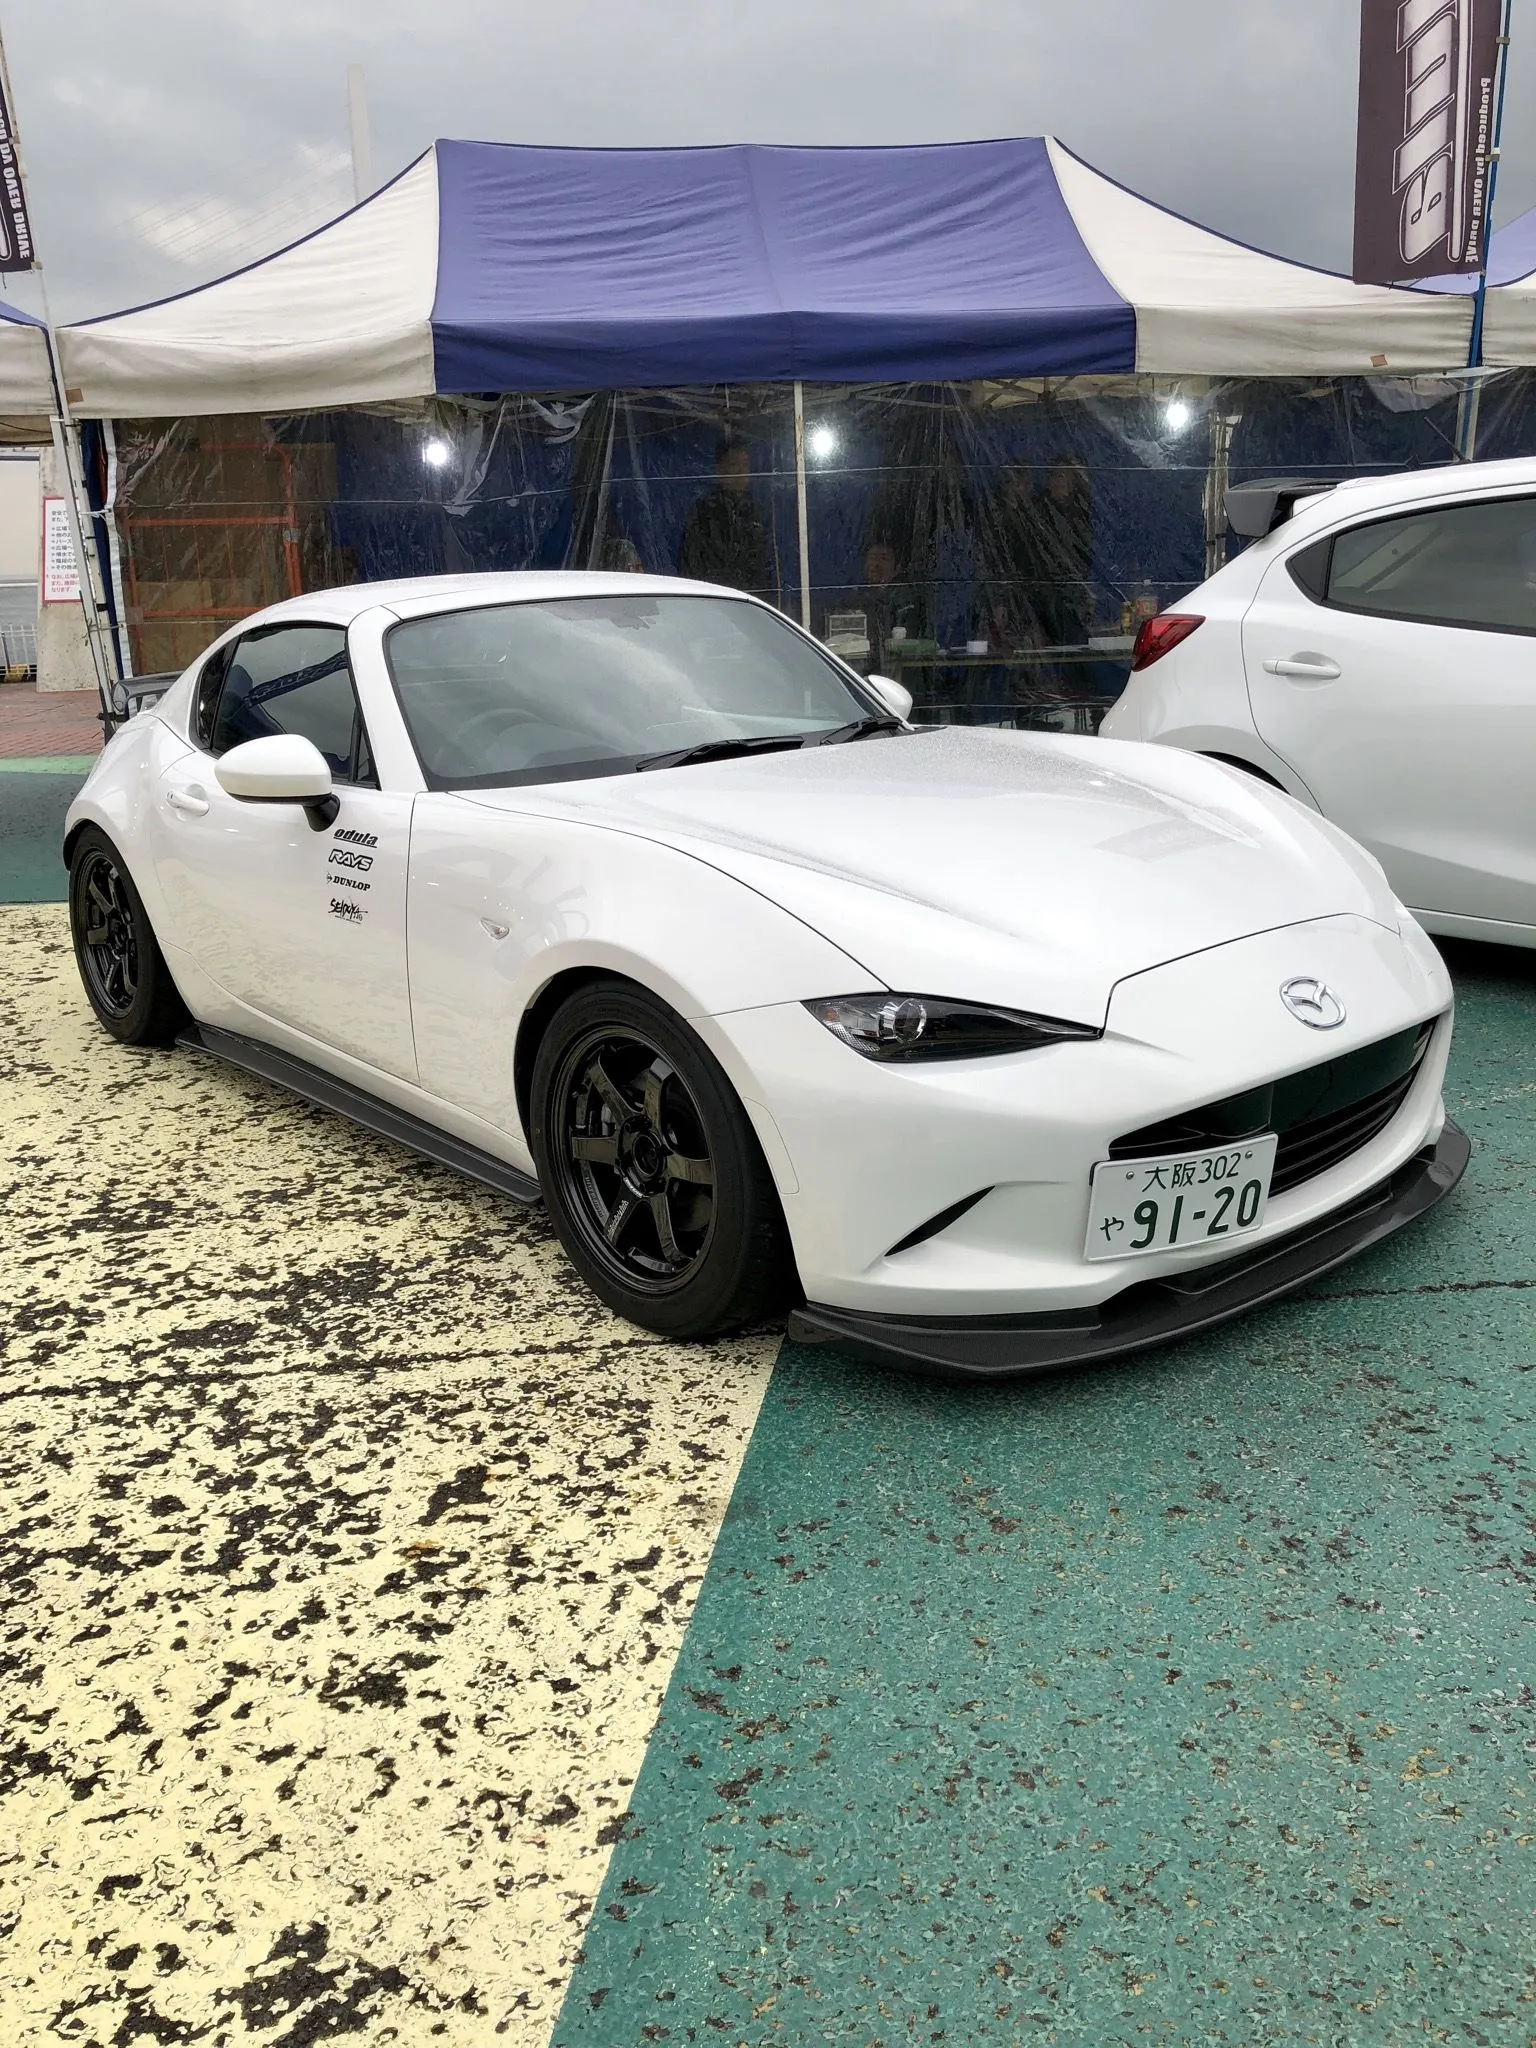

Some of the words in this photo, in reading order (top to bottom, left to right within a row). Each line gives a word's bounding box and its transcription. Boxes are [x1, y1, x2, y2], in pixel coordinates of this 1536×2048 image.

[333, 828, 378, 847] odula
[328, 849, 374, 871] RAYS
[333, 875, 371, 892] DUNLOP
[1099, 1216, 1125, 1241] や
[1130, 1179, 1263, 1249] 91-20
